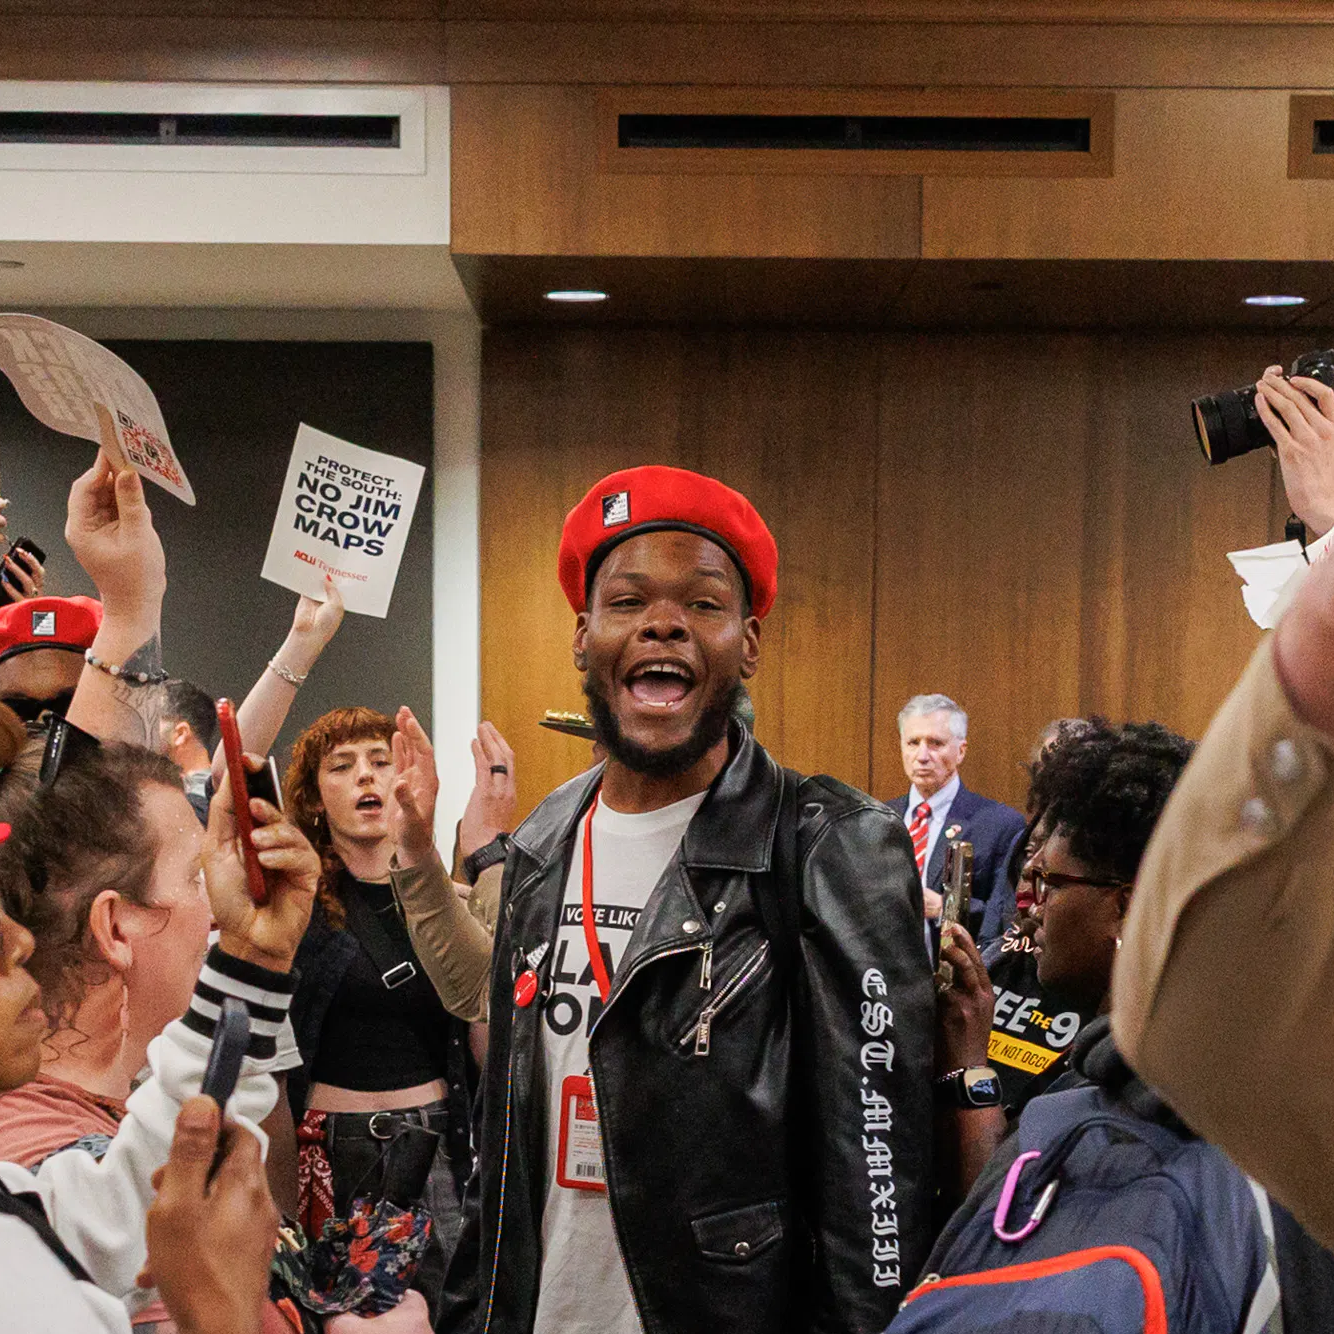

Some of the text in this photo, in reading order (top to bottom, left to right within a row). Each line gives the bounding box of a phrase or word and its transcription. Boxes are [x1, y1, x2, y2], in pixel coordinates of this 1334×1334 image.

[304, 461, 402, 501] THE SOUTH:
[317, 455, 395, 488] PROTECT
[297, 472, 402, 521] NO JIM
[293, 513, 385, 557] MAPS
[295, 494, 394, 538] CROW
[318, 560, 368, 582] Tennessee
[567, 907, 605, 923] VOE
[1029, 1010, 1053, 1030] THE
[1045, 1012, 1080, 1048] 9
[1001, 1043, 1023, 1063] NOT
